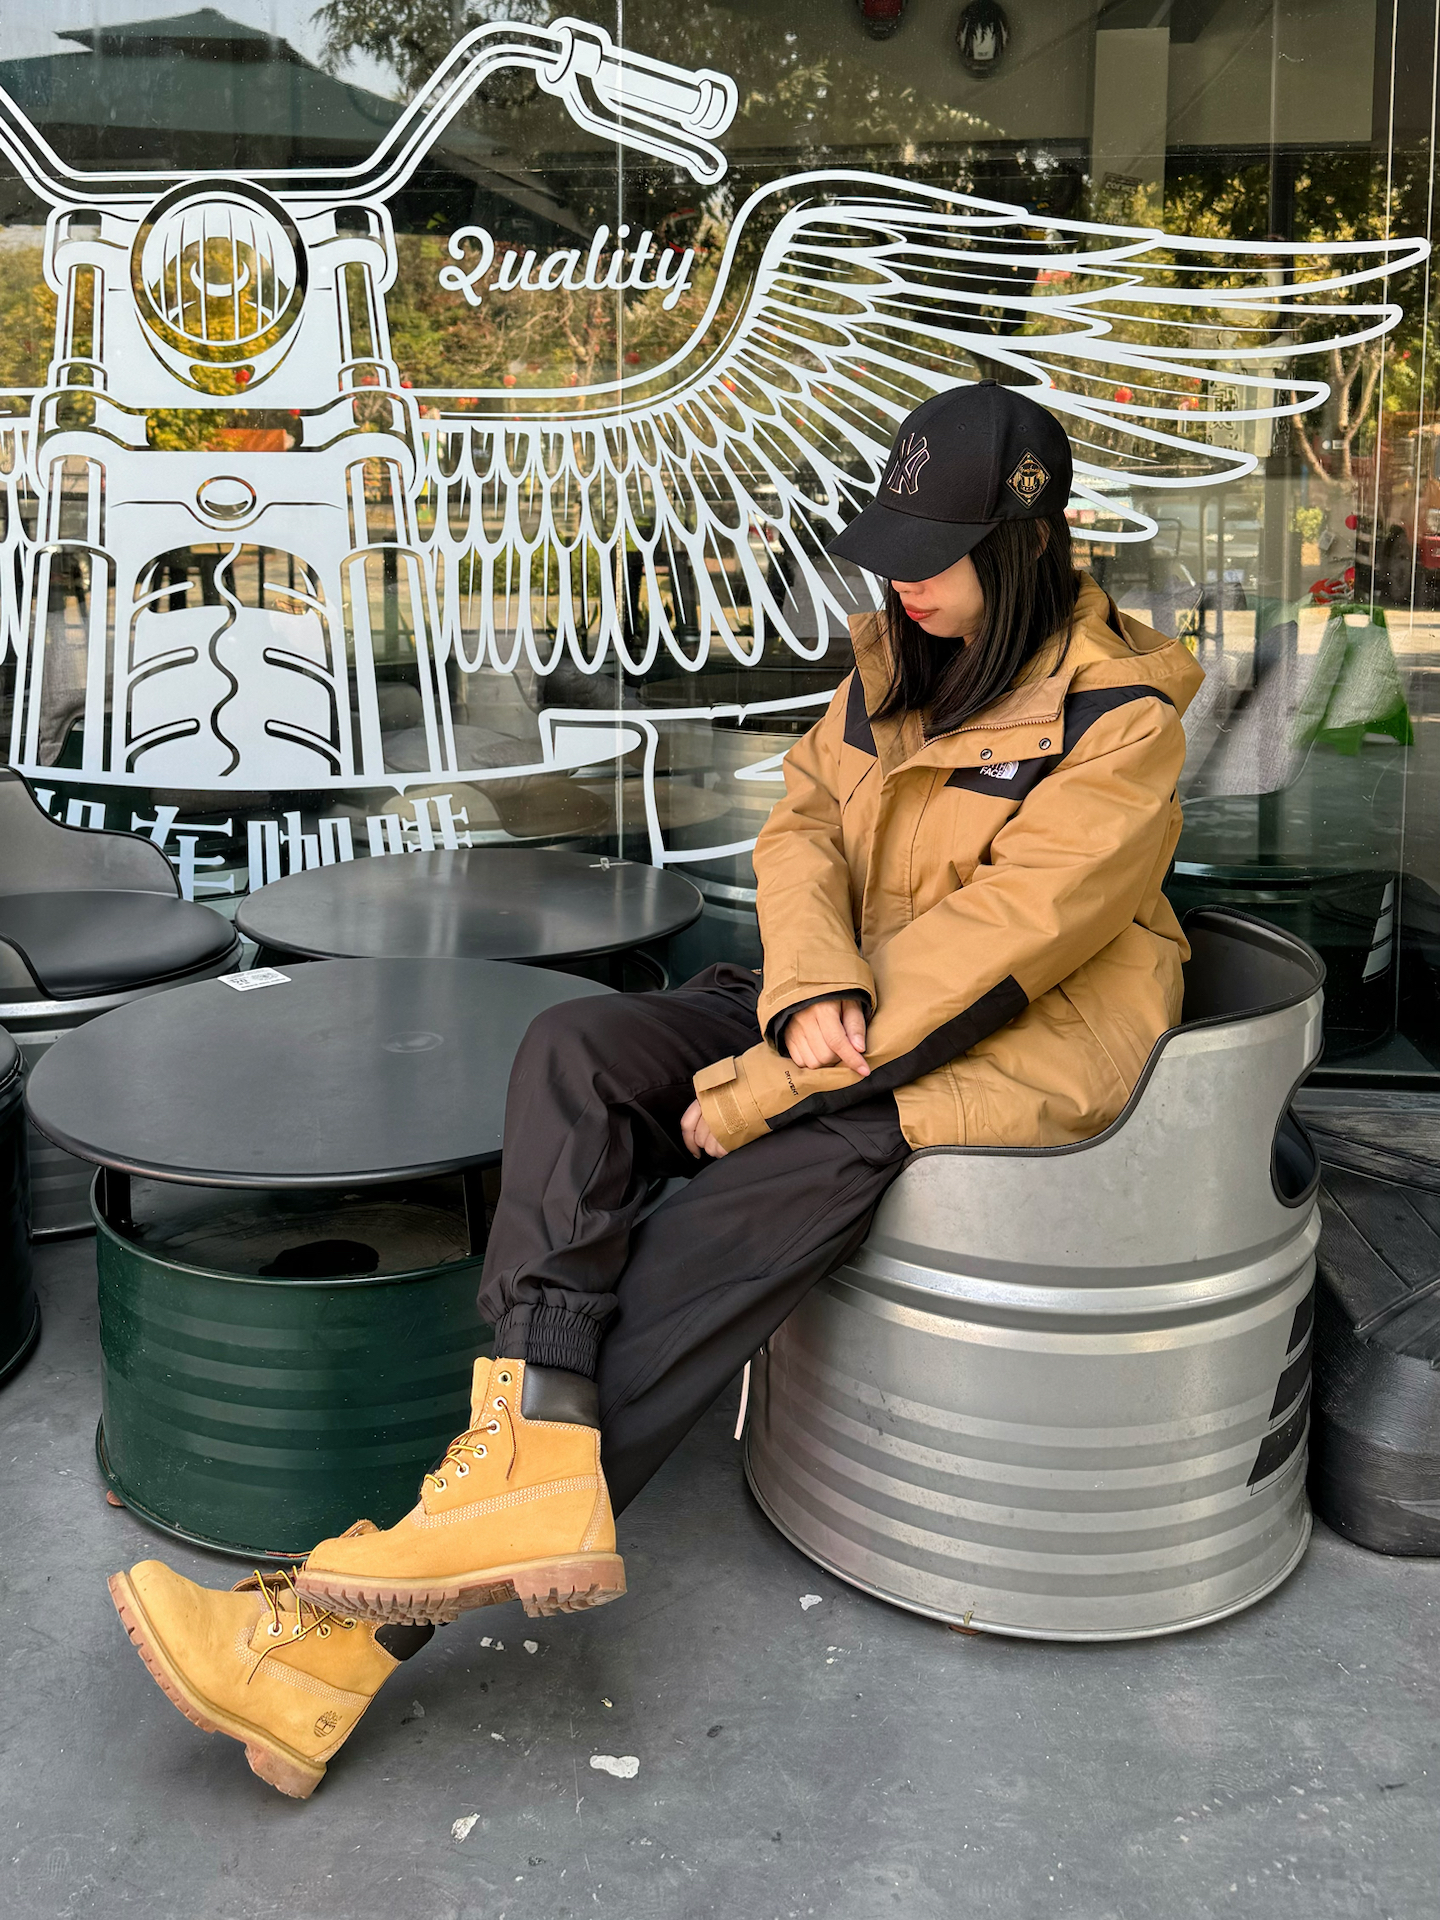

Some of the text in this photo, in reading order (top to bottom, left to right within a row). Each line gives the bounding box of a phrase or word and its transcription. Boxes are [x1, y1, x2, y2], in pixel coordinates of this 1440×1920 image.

[438, 224, 696, 311] Quality
[886, 432, 931, 495] NY
[979, 765, 1006, 779] FACE
[34, 787, 474, 904] 车咖啡
